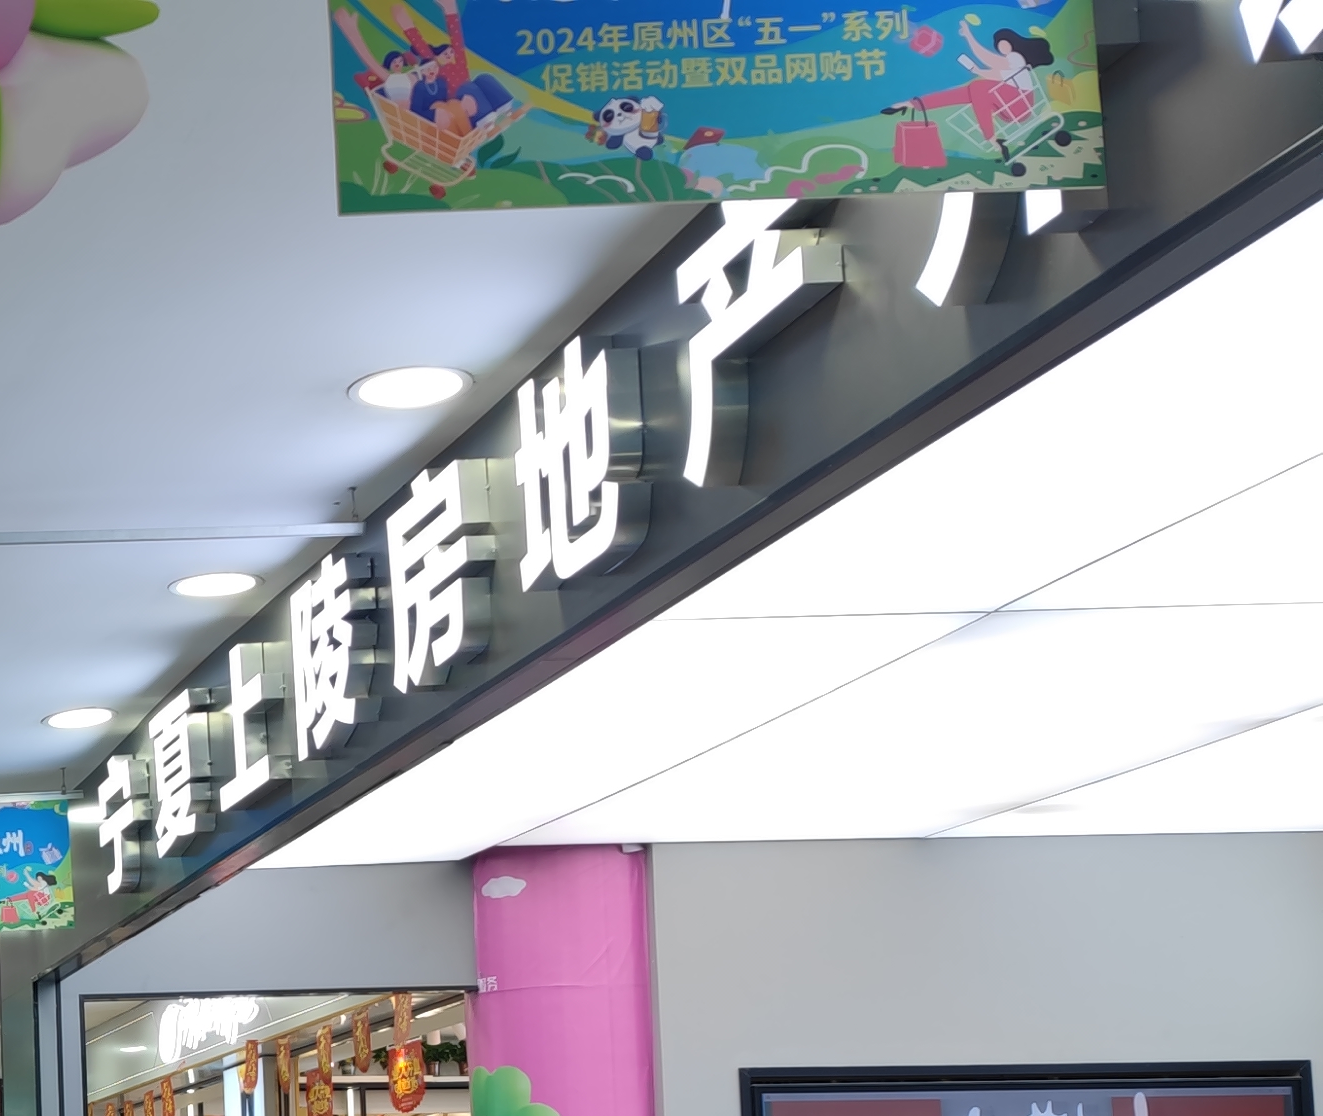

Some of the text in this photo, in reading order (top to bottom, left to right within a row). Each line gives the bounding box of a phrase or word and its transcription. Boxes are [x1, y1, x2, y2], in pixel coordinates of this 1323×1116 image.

[516, 8, 909, 57] 2024年原州区“五一”系列
[540, 49, 889, 93] 促销活动暨双品网购节
